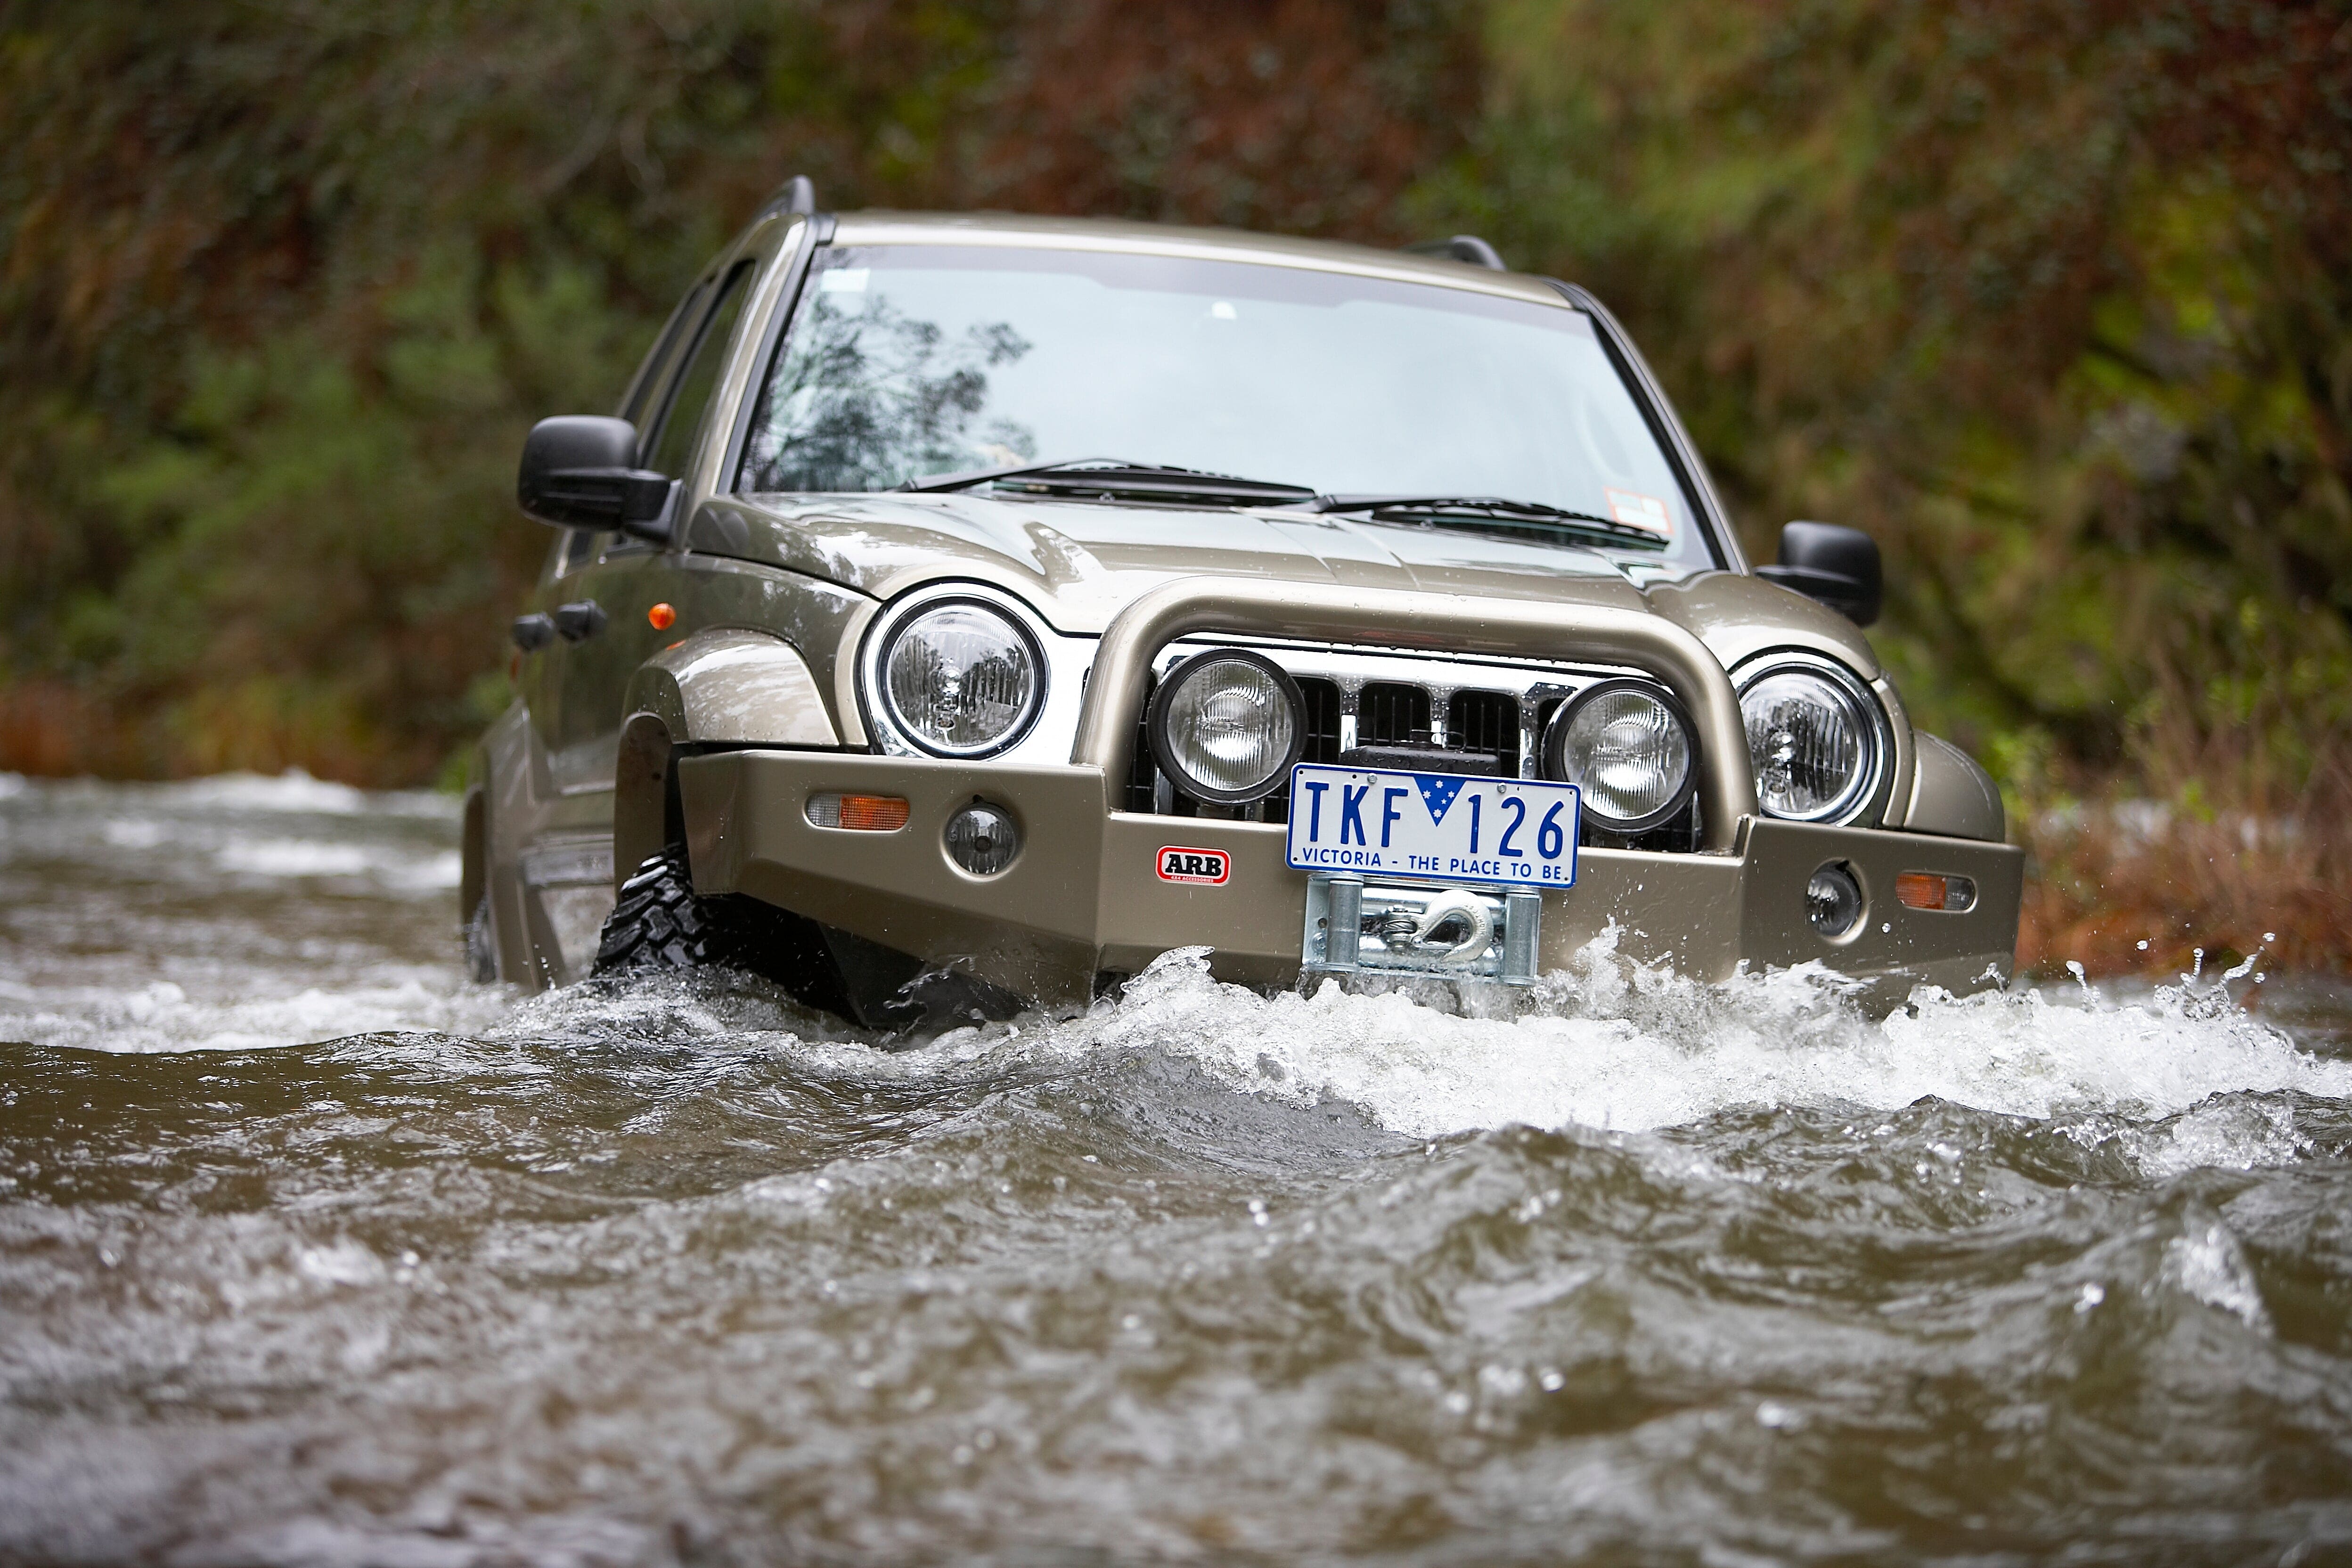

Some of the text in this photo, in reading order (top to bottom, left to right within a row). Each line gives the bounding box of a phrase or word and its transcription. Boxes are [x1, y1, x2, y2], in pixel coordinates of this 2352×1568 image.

[1305, 782, 1564, 859] TKF 126
[1165, 854, 1222, 876] ARB
[1303, 848, 1381, 866] VICTORIA
[1409, 855, 1438, 871] THE
[1450, 858, 1500, 875] PLACE
[1511, 862, 1532, 878] TO
[1542, 865, 1560, 880] BE
